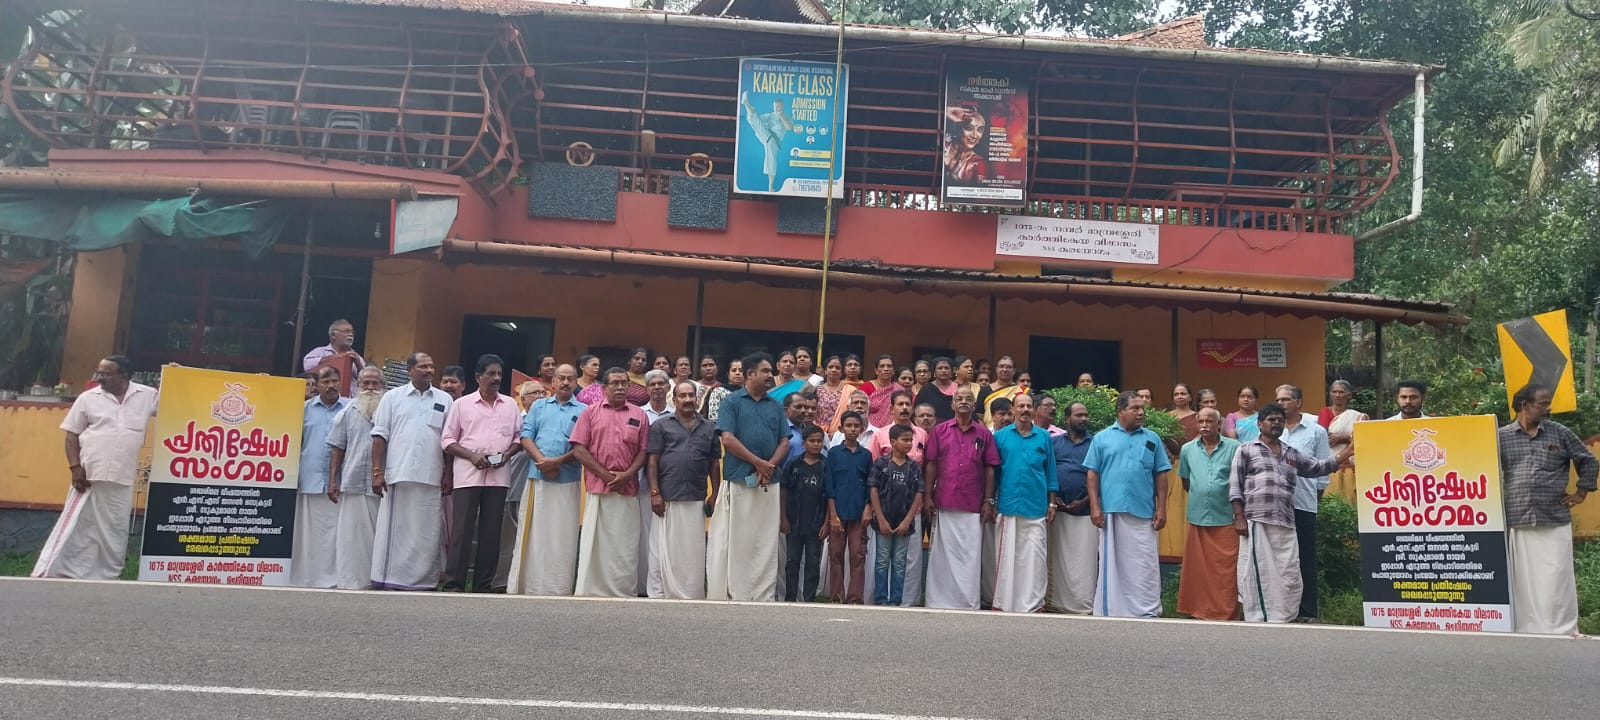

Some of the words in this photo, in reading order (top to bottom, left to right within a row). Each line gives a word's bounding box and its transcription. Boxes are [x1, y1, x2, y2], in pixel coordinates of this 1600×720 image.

[753, 72, 796, 94] KARATE
[798, 74, 833, 96] CLASS
[792, 98, 826, 110] ADMISSION
[792, 110, 818, 122] STARTED
[164, 420, 290, 461] പ്രതിഷേധ
[170, 456, 286, 482] സംഗമം
[1365, 471, 1487, 508] പ്രതിഷേധ
[1374, 504, 1488, 527] സംഗമം
[178, 534, 217, 543] ശക്തമായ
[218, 534, 260, 544] പ്രതിഷേധം
[149, 560, 164, 571] 1075
[206, 561, 254, 572] കാർത്തികേയ
[256, 562, 284, 573] വിലാസം
[168, 574, 182, 583] NSS
[1393, 582, 1428, 590] ശക്തമായ
[1432, 580, 1472, 590] പ്രതിഷേധം
[1370, 608, 1386, 616] 1075
[1424, 606, 1471, 618] കാർത്തികേയ
[1474, 607, 1502, 620] വിലാസം
[1390, 620, 1402, 629] NSS
